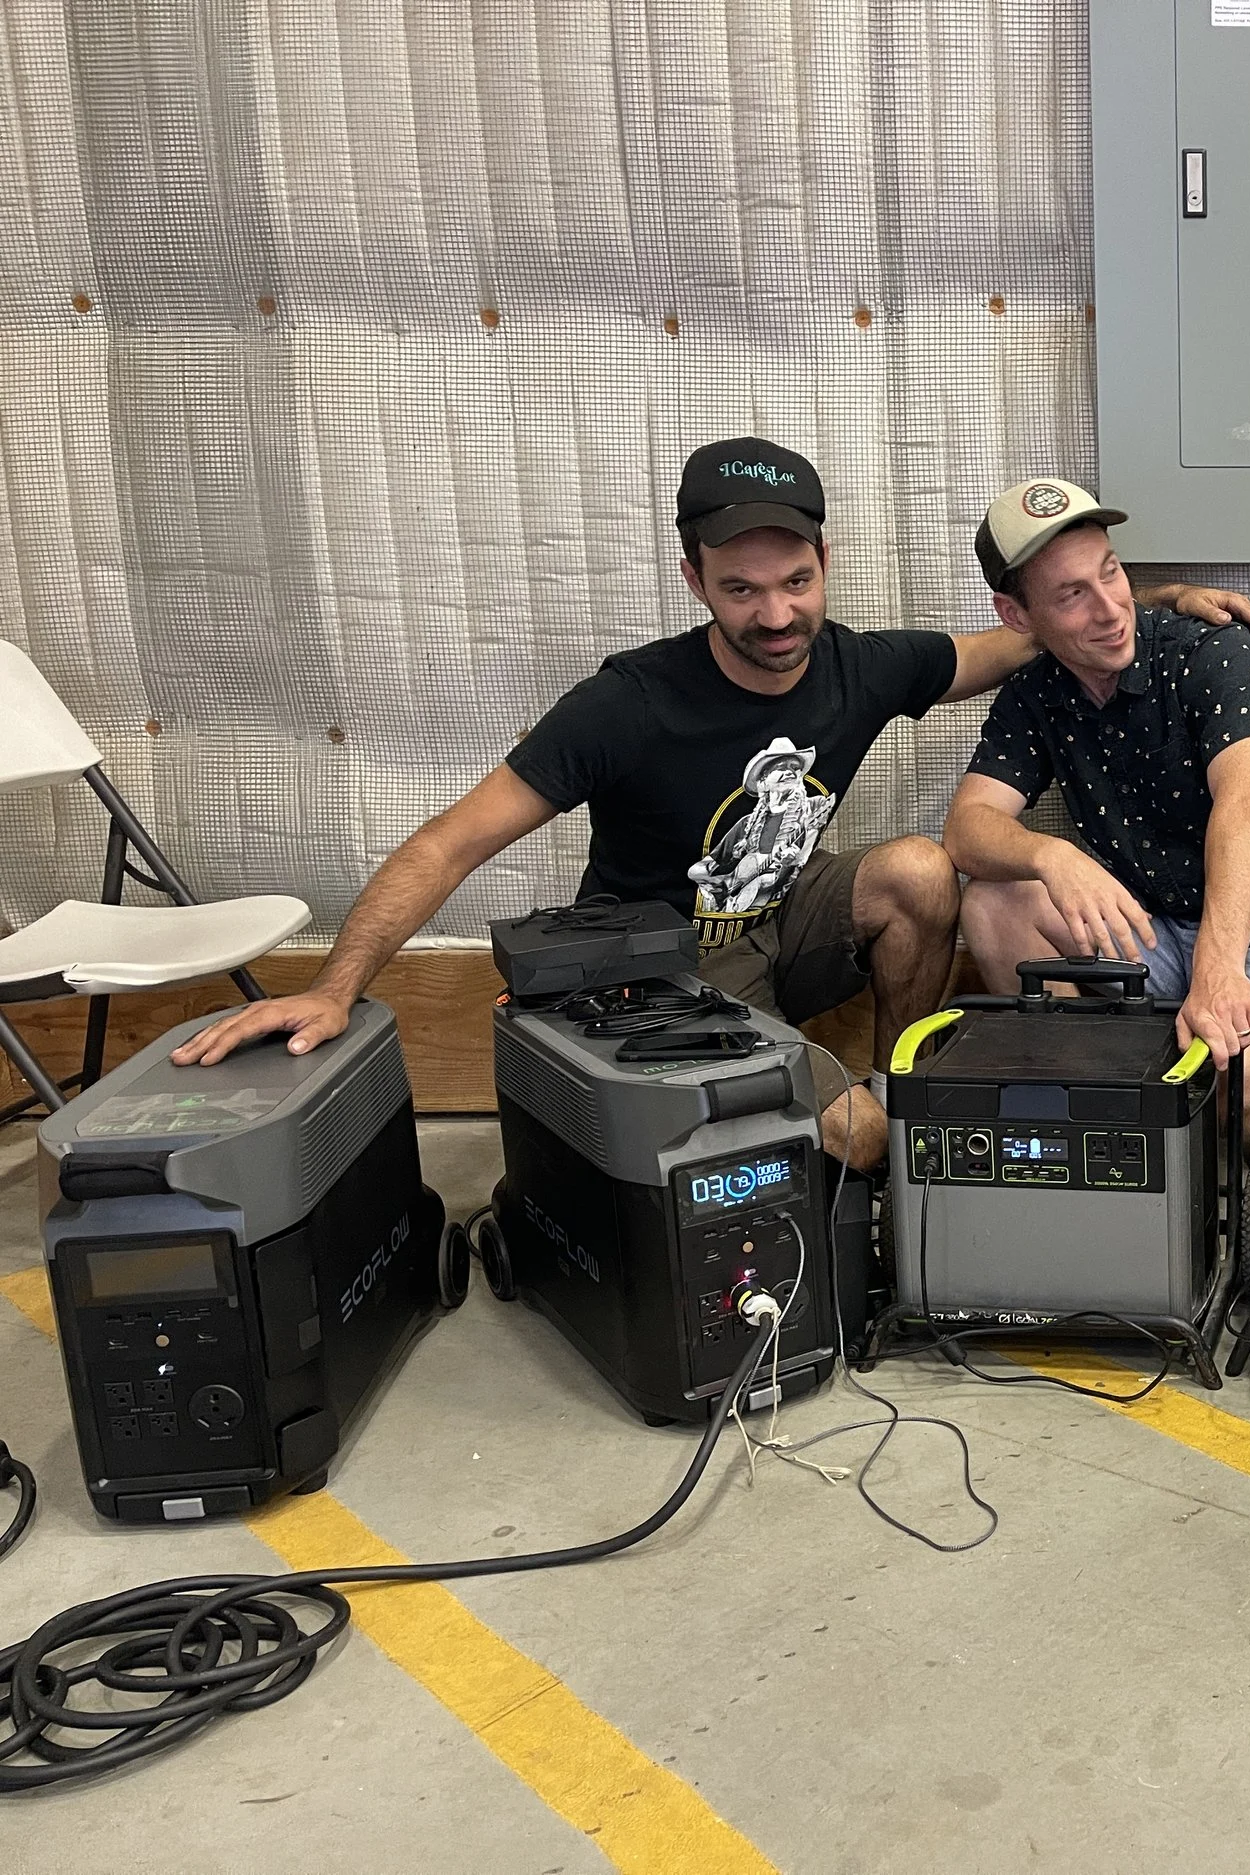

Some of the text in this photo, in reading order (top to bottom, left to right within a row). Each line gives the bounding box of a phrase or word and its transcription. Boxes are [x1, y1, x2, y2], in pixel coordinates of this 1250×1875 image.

[719, 462, 730, 477] I
[732, 460, 767, 478] Care
[767, 466, 797, 484] Lot
[756, 1162, 781, 1176] 0000
[757, 1172, 782, 1186] 0009
[692, 1174, 725, 1203] 03
[340, 1211, 411, 1324] ECOFLOW
